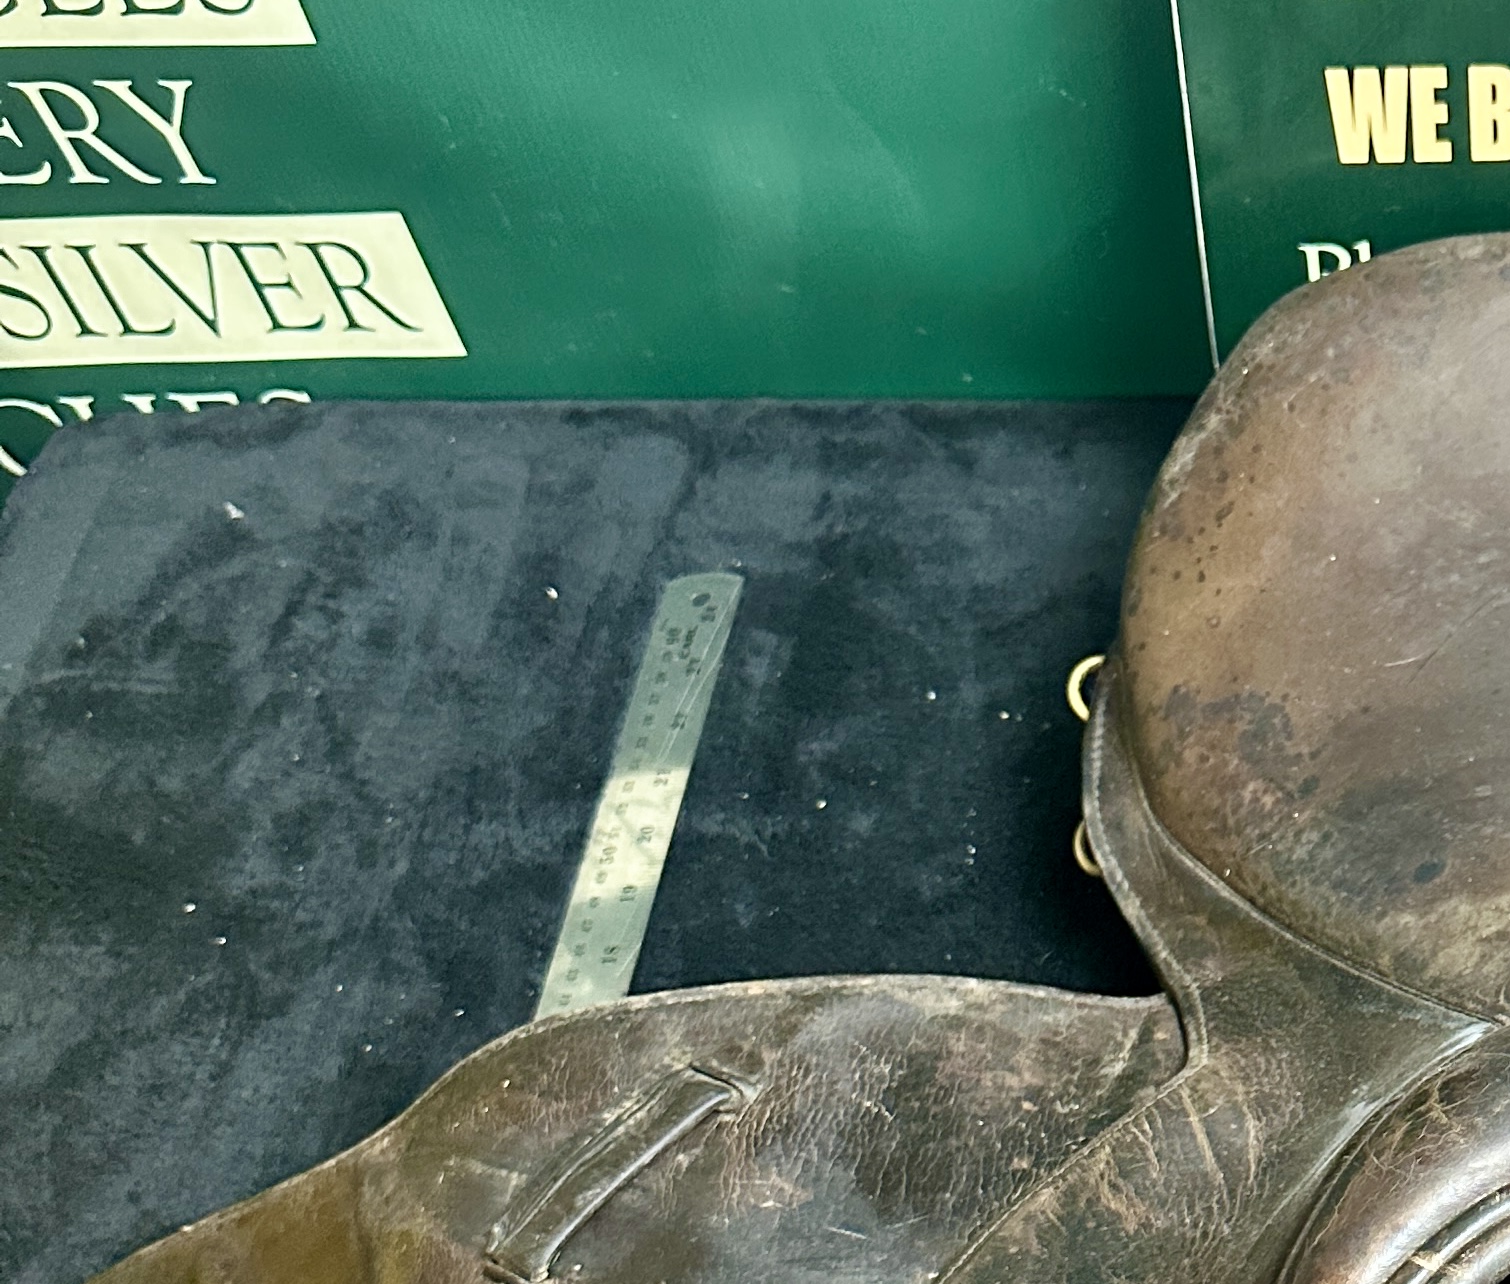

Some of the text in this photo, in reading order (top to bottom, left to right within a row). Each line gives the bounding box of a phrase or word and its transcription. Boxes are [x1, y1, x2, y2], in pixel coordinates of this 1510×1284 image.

[1323, 65, 1453, 165] WE
[0, 239, 424, 340] SILVER
[619, 884, 638, 902] 19
